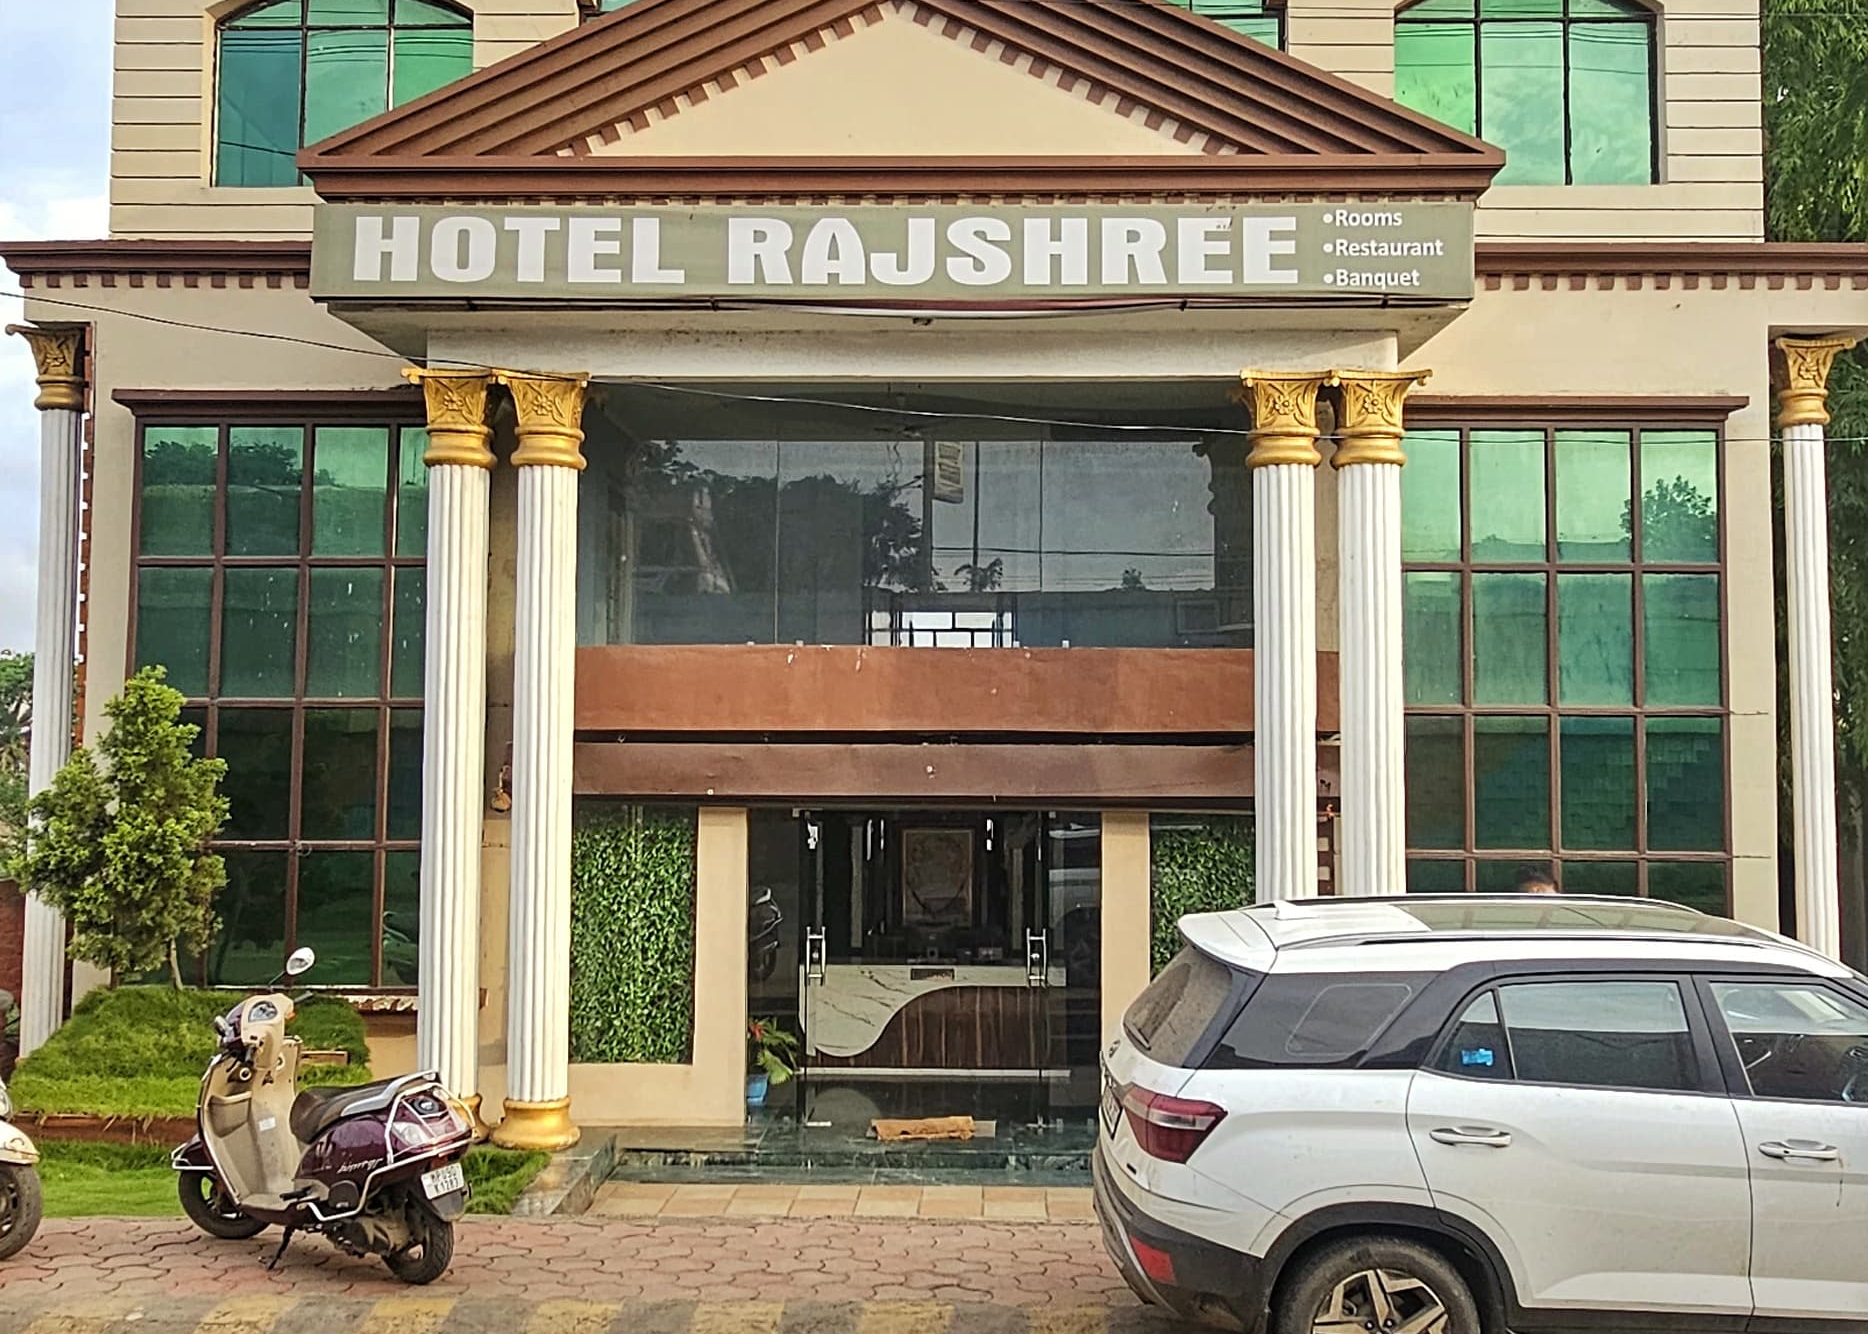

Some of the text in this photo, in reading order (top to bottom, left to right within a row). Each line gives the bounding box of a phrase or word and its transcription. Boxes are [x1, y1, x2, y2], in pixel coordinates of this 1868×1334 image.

[1335, 209, 1403, 227] Rooms
[353, 216, 1299, 285] HOTEL RAJSHREE
[1335, 238, 1444, 256] Restaurant
[1336, 268, 1420, 290] Banquet
